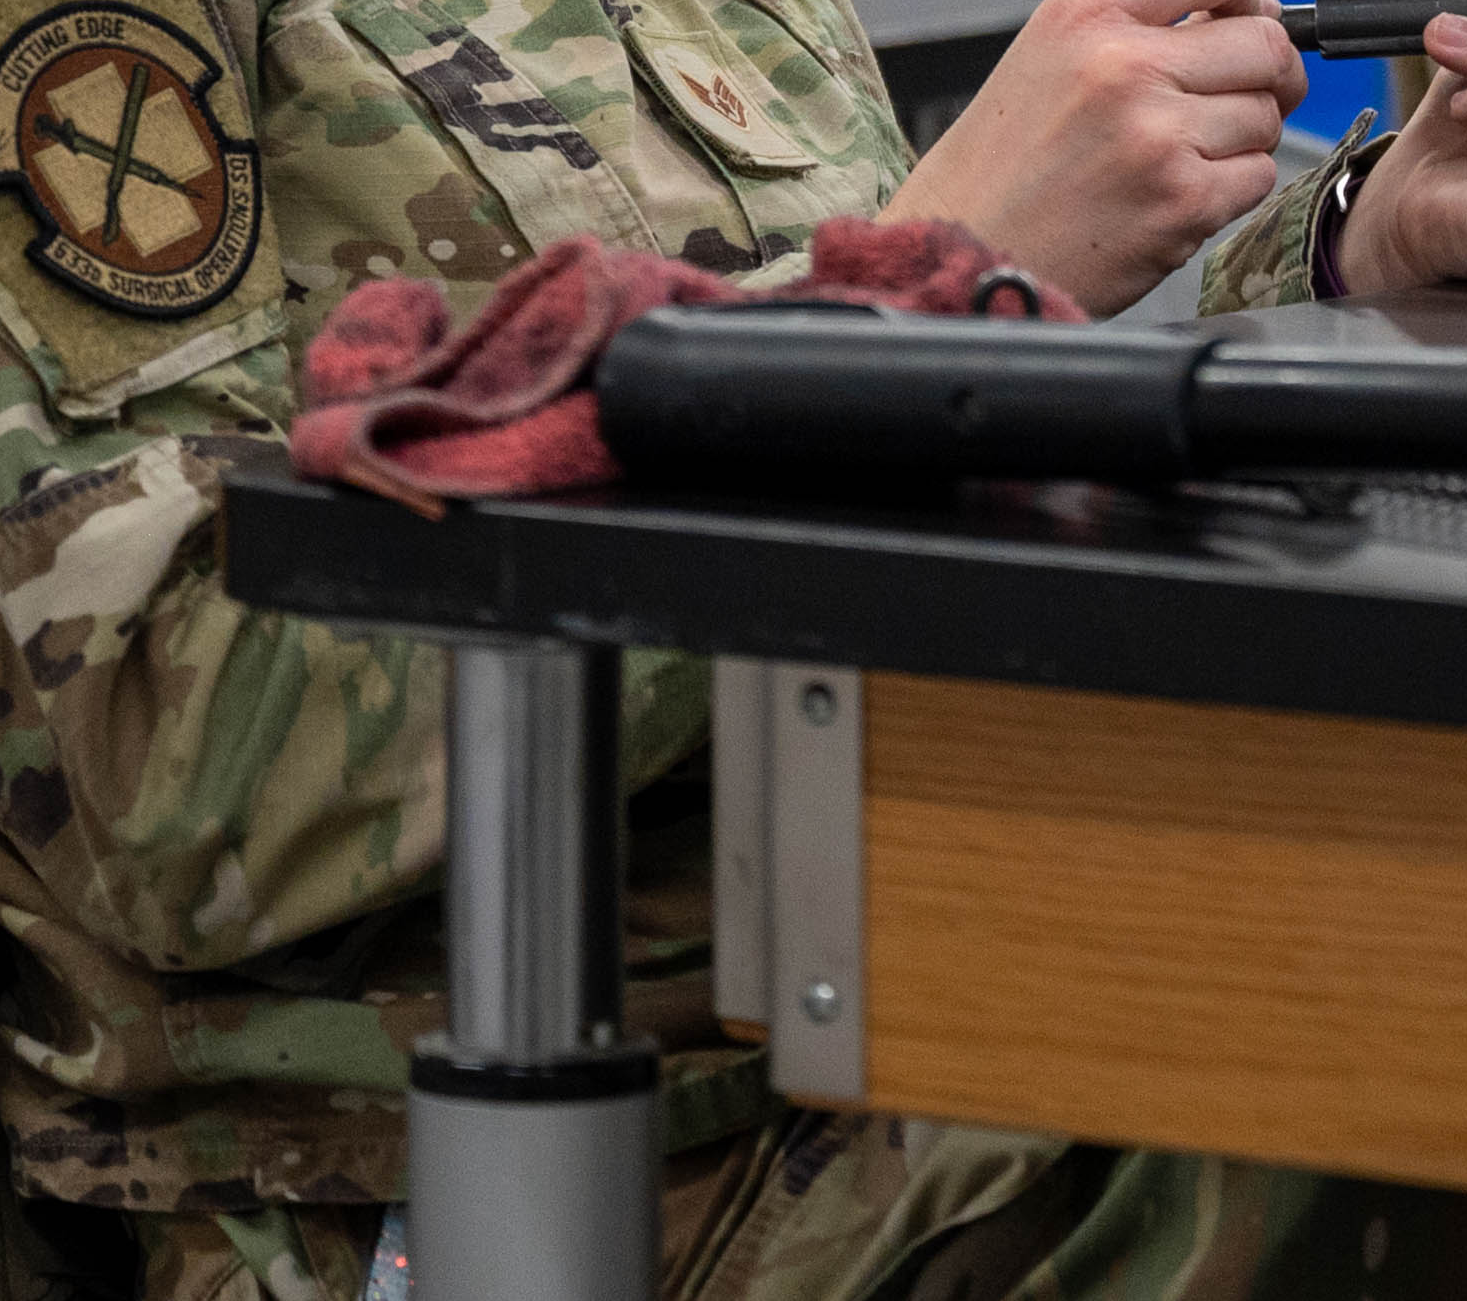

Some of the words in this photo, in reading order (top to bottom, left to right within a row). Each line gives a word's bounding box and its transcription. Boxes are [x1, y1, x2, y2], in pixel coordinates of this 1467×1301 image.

[1, 24, 69, 93] CUTTING
[75, 16, 125, 40] EDGE
[108, 271, 195, 300] SURGICAL
[194, 190, 249, 290] OPERATIONS
[229, 156, 249, 186] SQ
